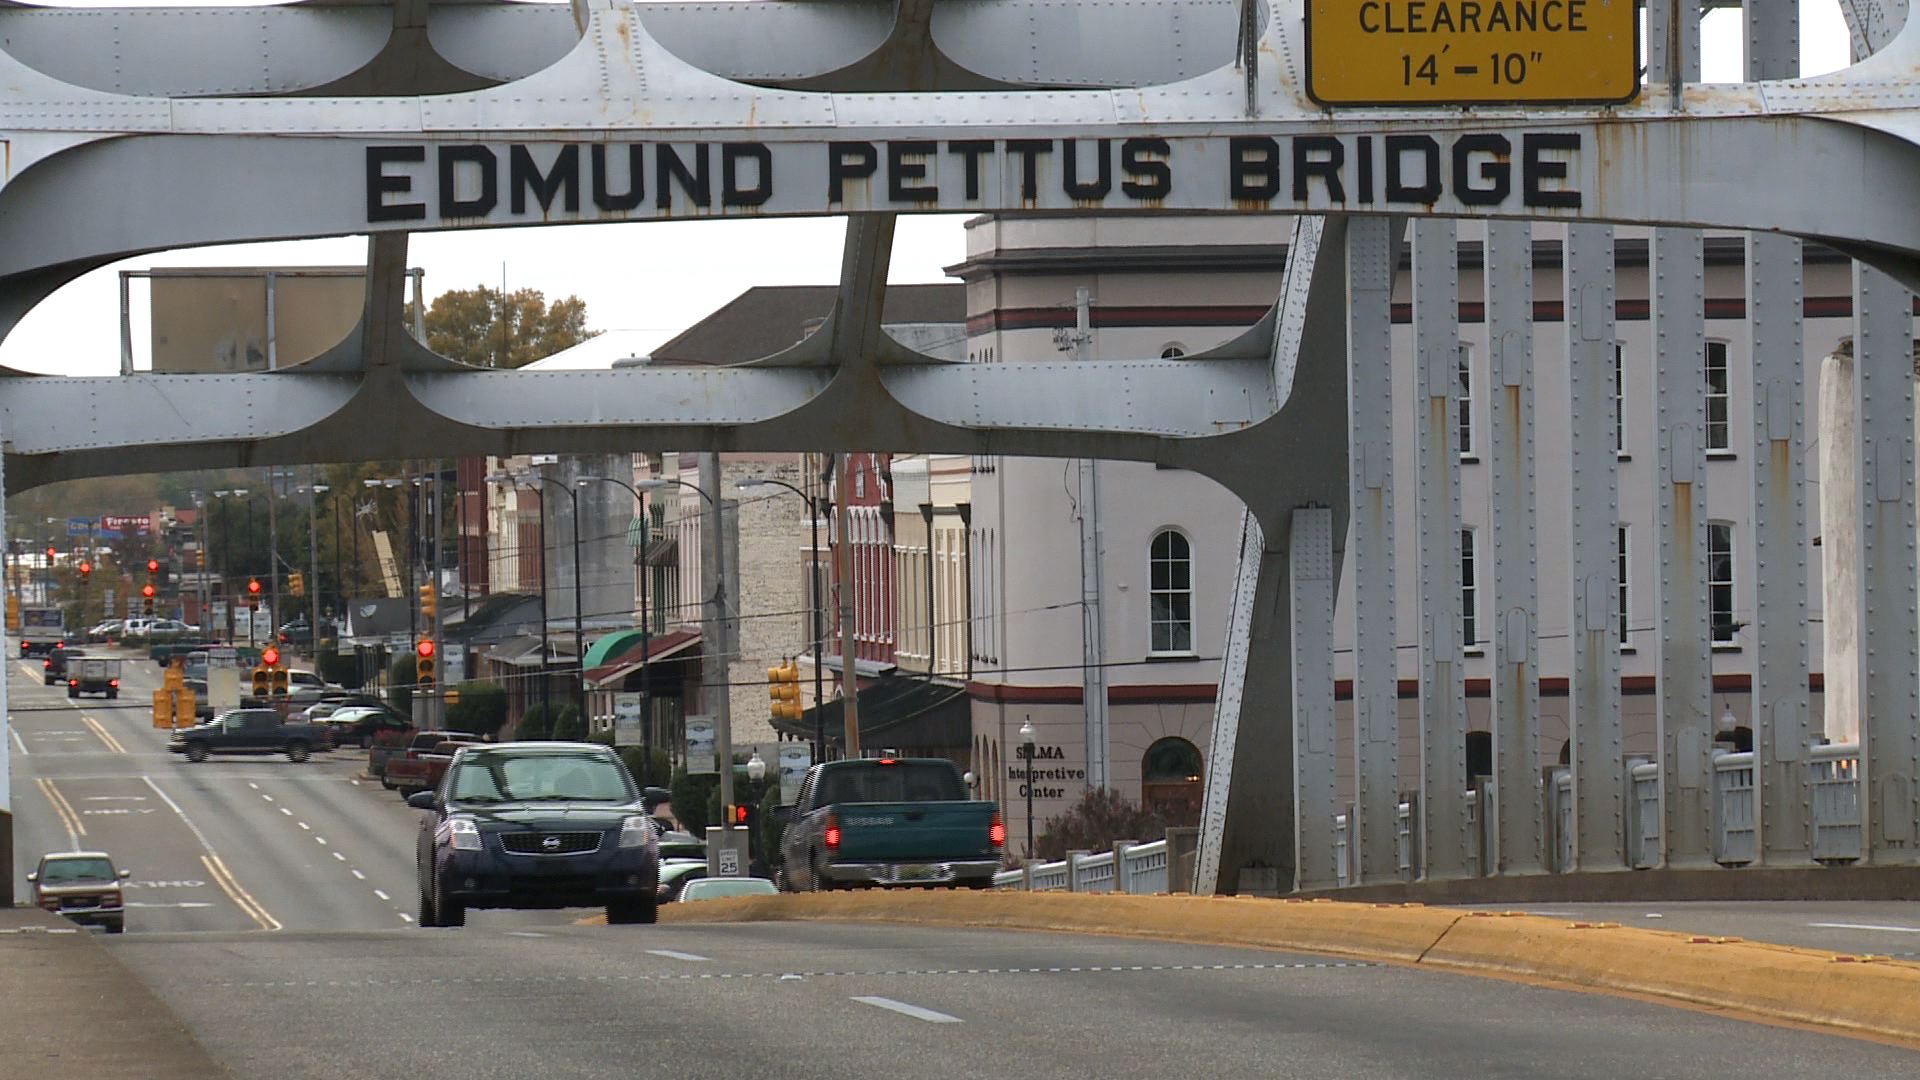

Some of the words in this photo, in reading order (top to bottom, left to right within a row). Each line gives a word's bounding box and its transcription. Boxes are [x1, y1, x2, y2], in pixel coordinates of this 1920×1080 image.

[1359, 0, 1588, 33] CLEARANCE
[366, 142, 772, 223] EDMUND
[829, 137, 1172, 203] PETTUS
[1230, 133, 1582, 208] BRIDGE
[1016, 746, 1065, 760] SLMA
[1019, 784, 1065, 798] Cnter
[721, 862, 738, 873] 25
